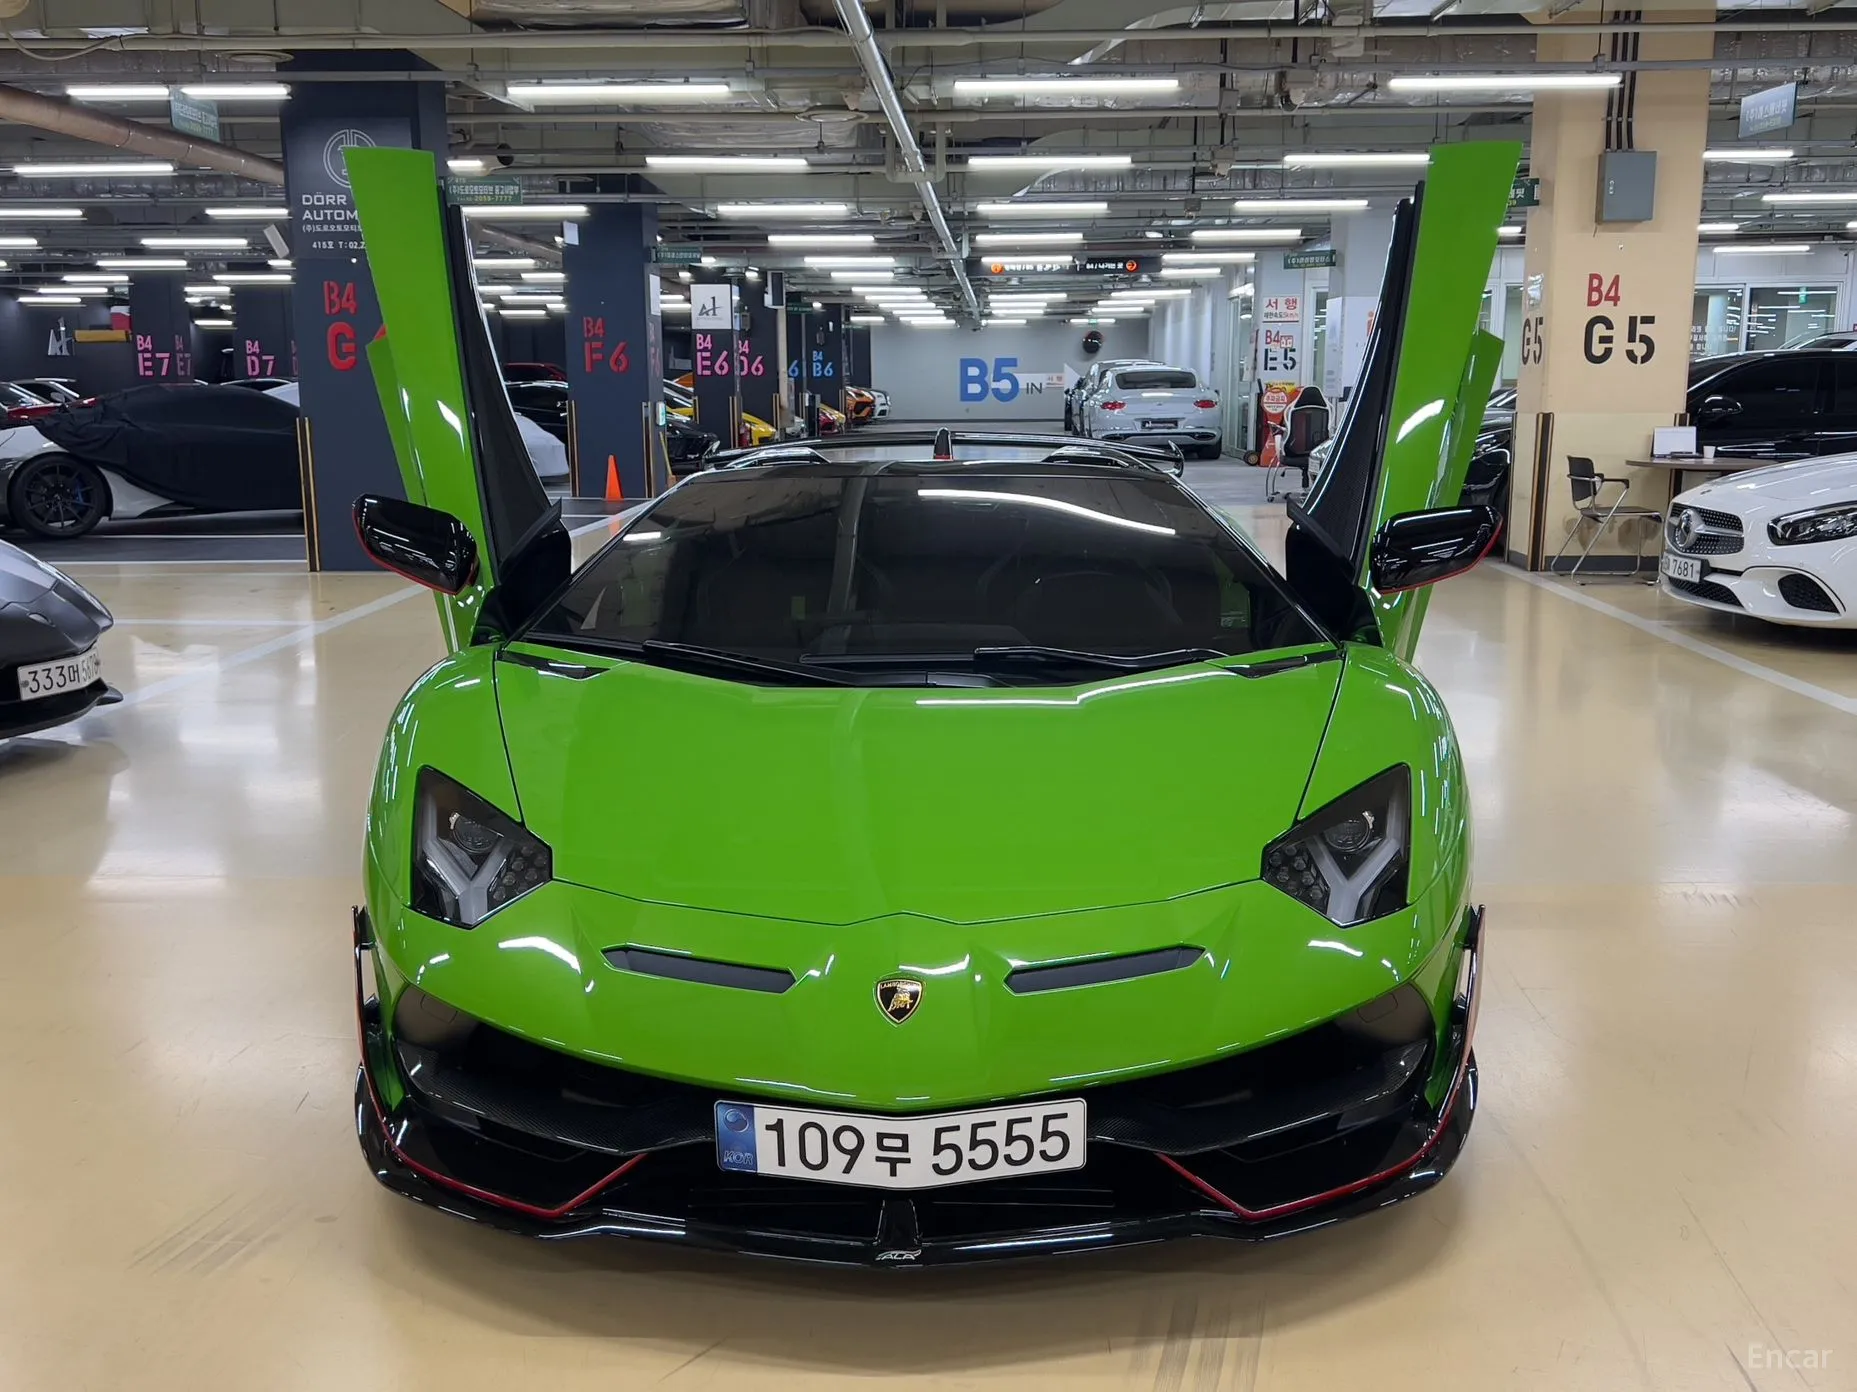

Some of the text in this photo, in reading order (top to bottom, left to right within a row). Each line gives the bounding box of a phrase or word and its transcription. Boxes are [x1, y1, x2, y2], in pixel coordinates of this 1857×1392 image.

[302, 192, 347, 205] DÖRR
[324, 281, 356, 315] B4
[1587, 273, 1620, 307] B4
[583, 317, 605, 338] B4
[1265, 329, 1280, 345] B4
[136, 335, 152, 350] B4
[246, 340, 260, 354] B4
[696, 333, 712, 350] B4
[1522, 317, 1543, 365] G5
[1584, 315, 1655, 364] G5
[138, 353, 170, 376] E7
[247, 355, 275, 376] D7
[584, 341, 629, 373] F6
[697, 350, 729, 376] E6
[813, 351, 823, 361] B4
[813, 362, 833, 376] B6
[960, 358, 1043, 402] B5 IN
[1673, 559, 1694, 578] 7681
[28, 664, 80, 693] 333머
[765, 1113, 1070, 1177] 109무 5555
[723, 1151, 754, 1165] KOR
